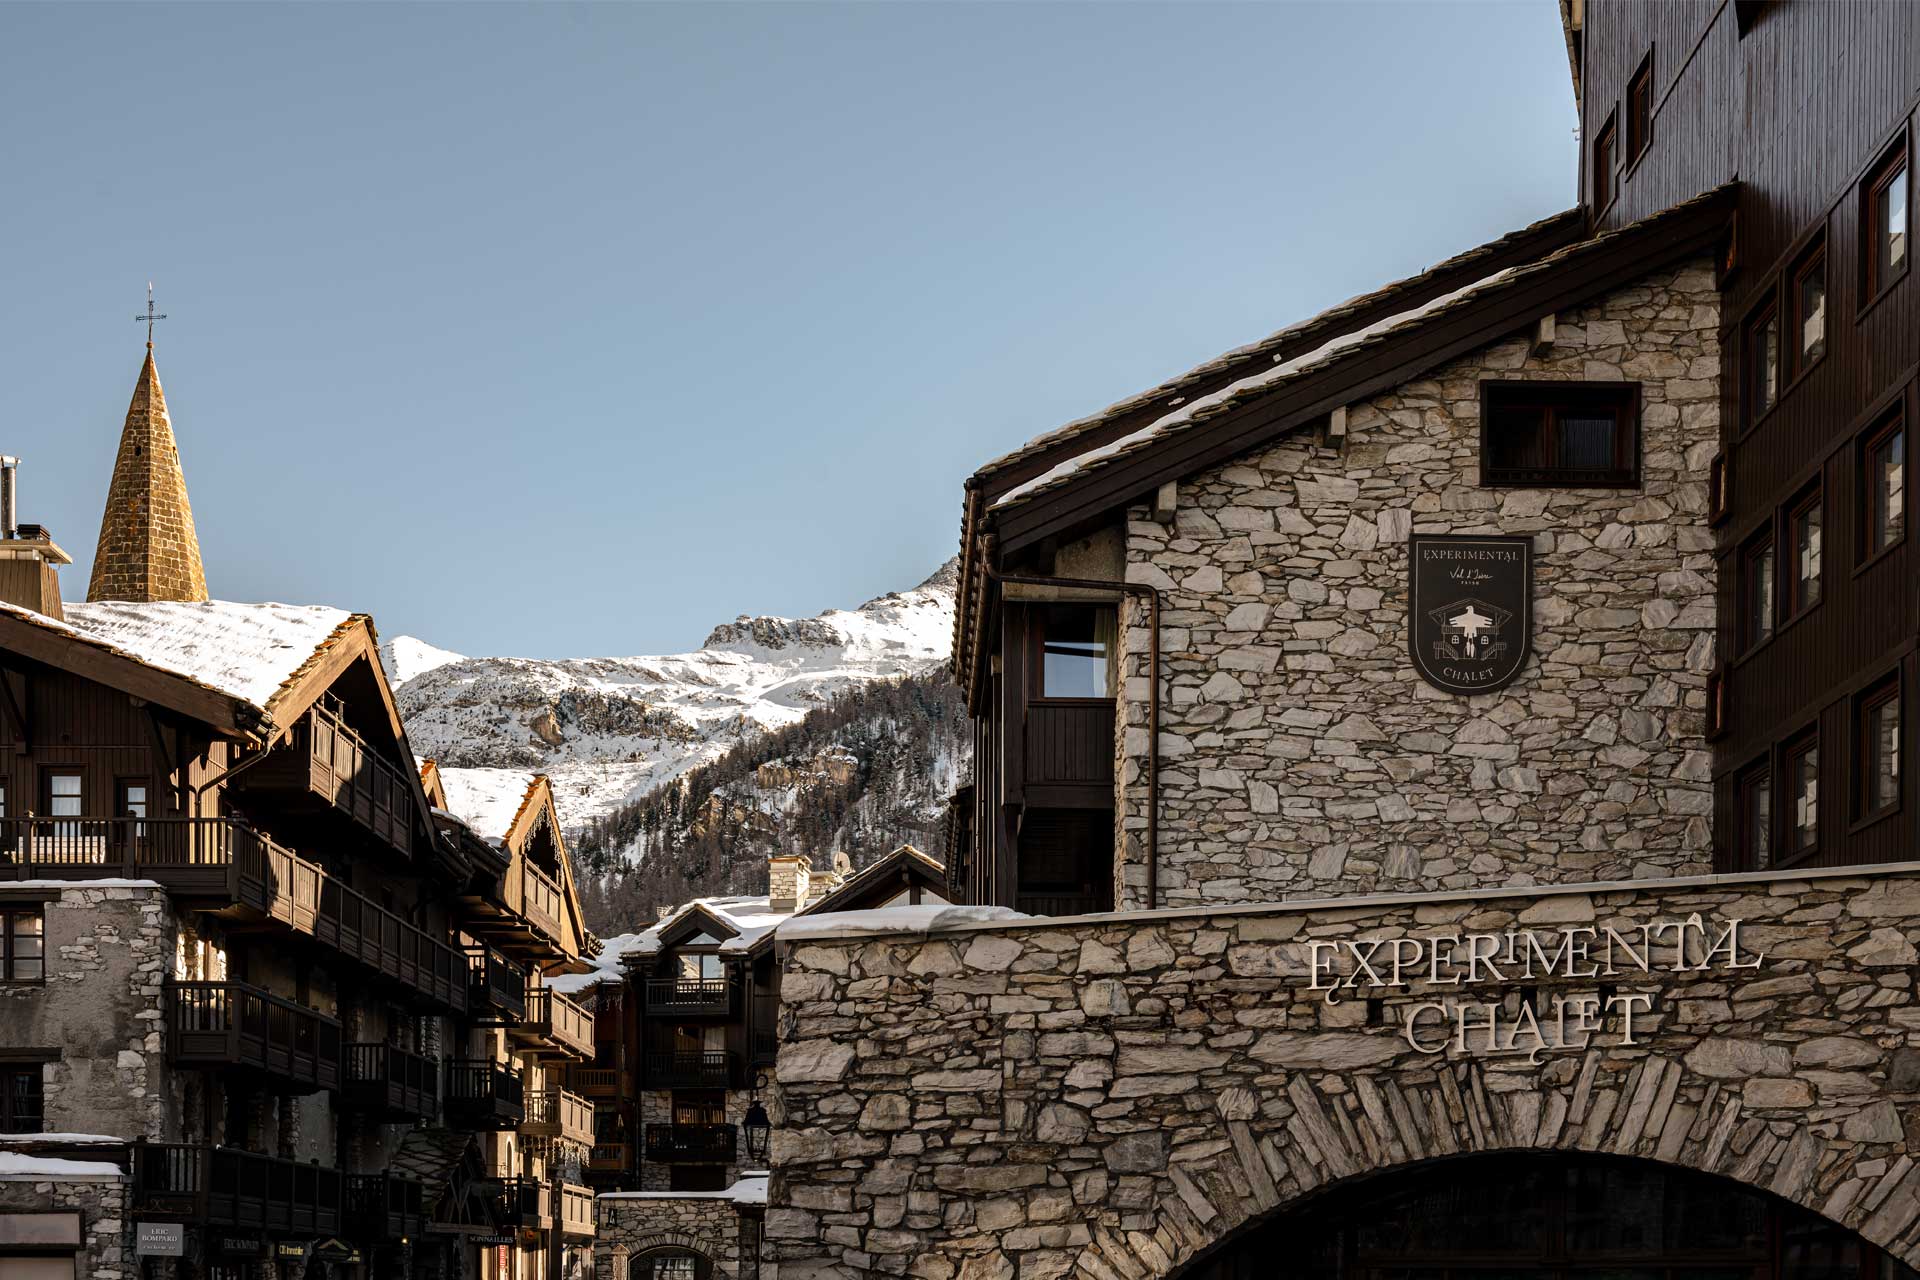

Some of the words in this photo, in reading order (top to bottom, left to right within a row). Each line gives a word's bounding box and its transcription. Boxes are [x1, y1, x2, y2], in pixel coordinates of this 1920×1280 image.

[1423, 549, 1519, 563] EXPERIMENTAL
[1443, 666, 1494, 684] CHALET
[1306, 912, 1765, 1007] EXPERIMENTAL
[1406, 993, 1653, 1067] CHALET
[142, 1234, 178, 1242] BOMPARD
[469, 1236, 514, 1244] SONNAILLES
